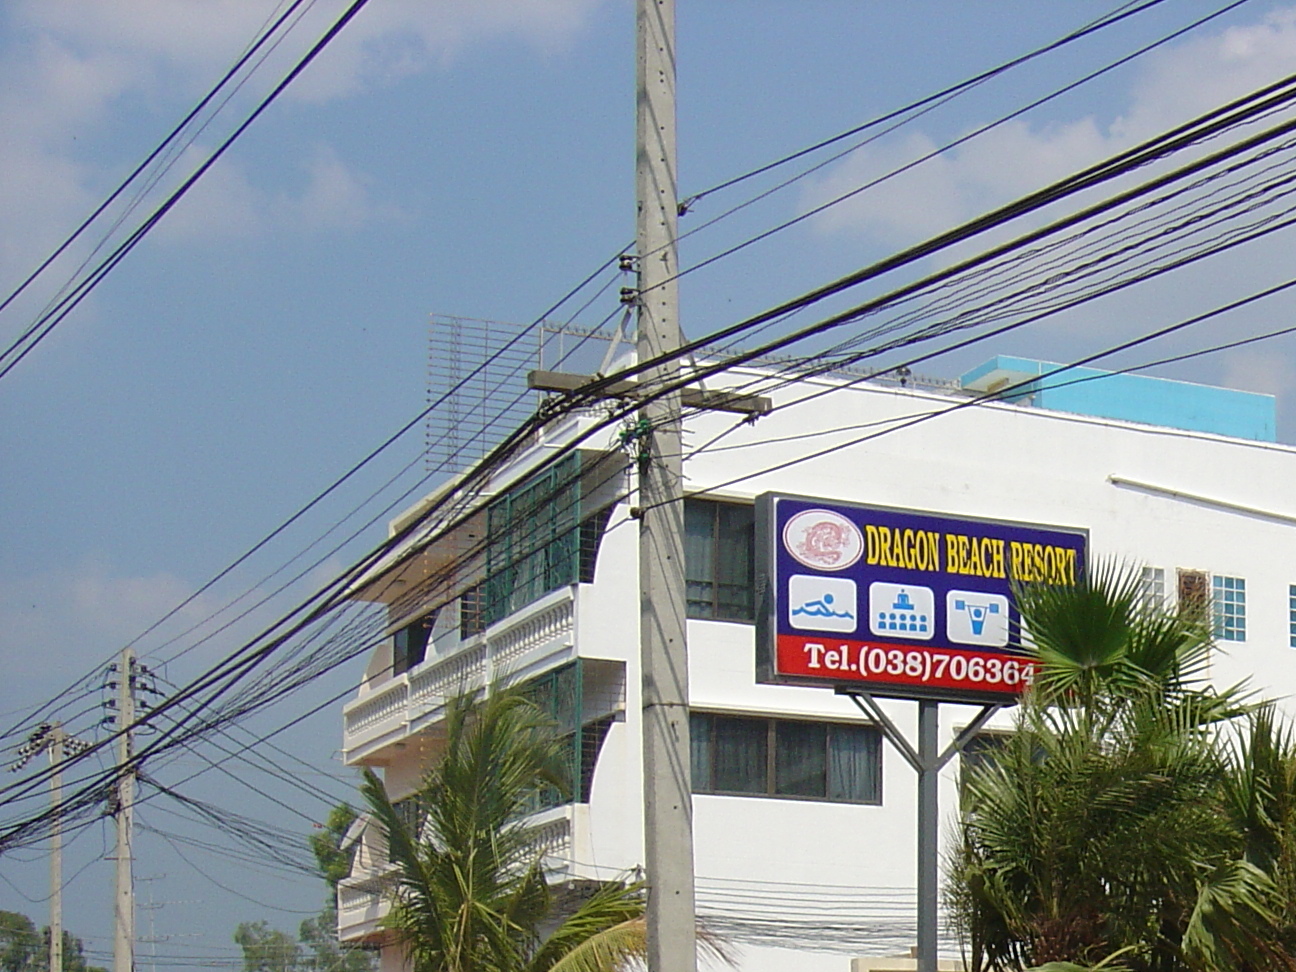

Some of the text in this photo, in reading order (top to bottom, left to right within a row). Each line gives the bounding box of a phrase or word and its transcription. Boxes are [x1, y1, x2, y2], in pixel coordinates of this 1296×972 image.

[865, 525, 1076, 587] DRAGON BEACH RESORT
